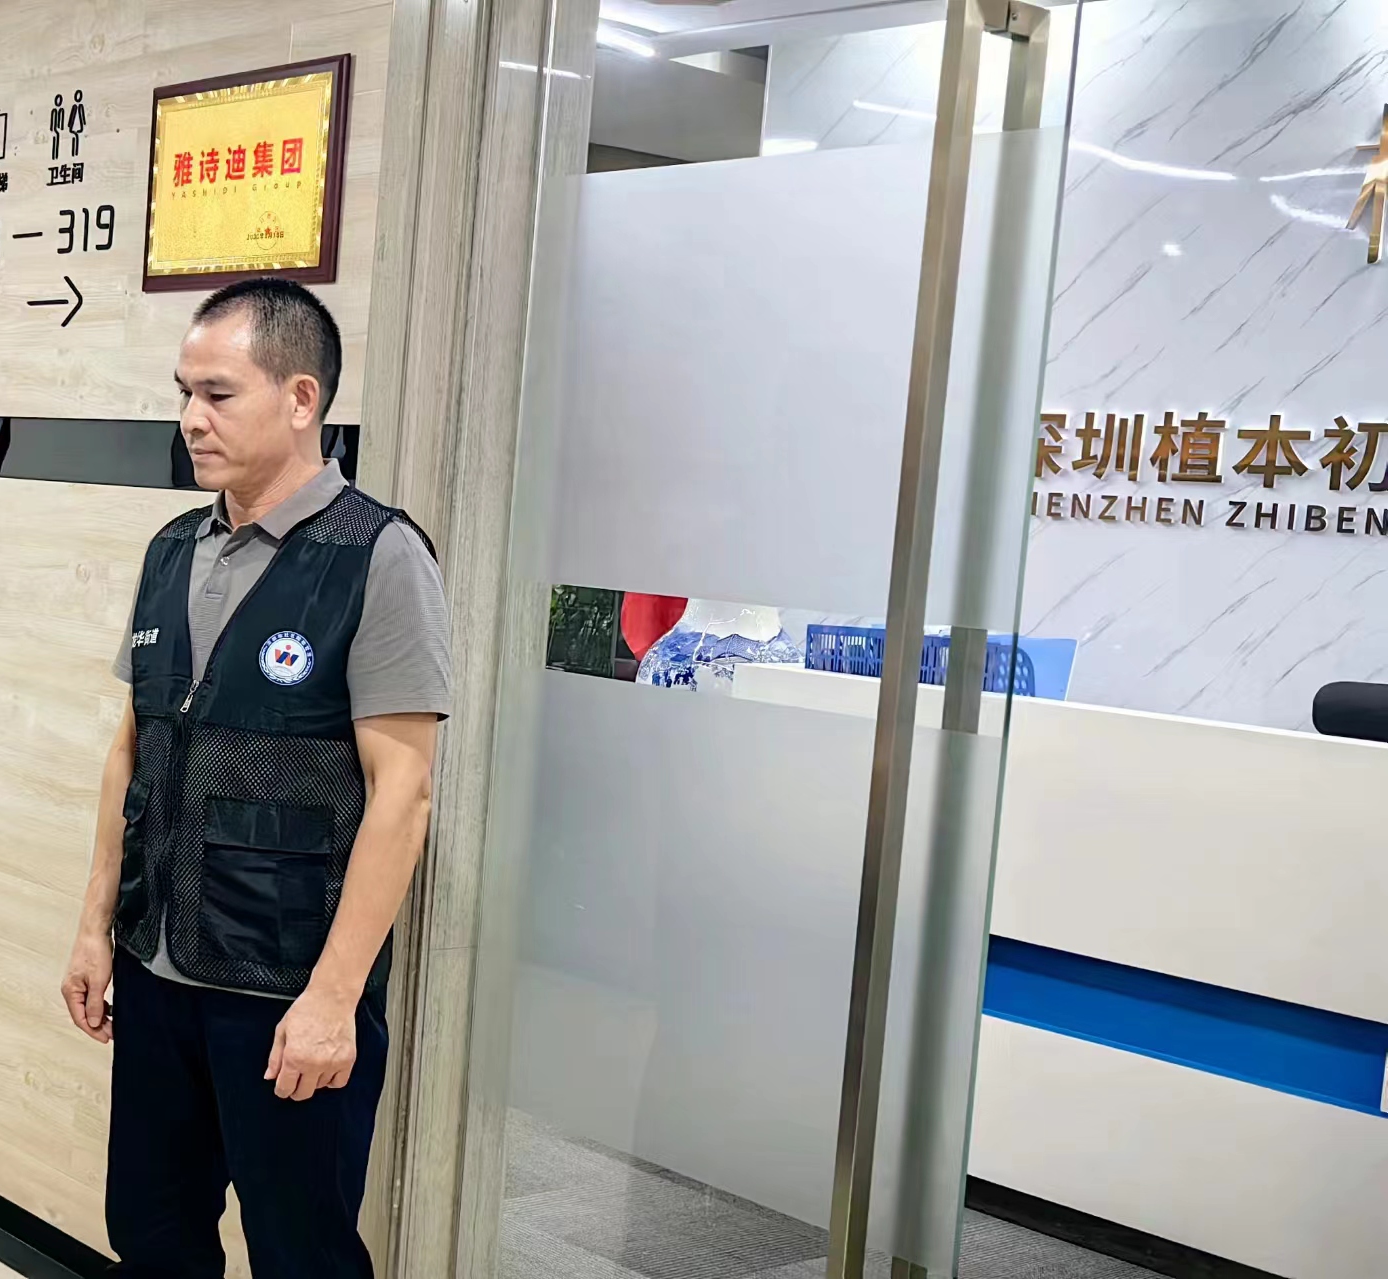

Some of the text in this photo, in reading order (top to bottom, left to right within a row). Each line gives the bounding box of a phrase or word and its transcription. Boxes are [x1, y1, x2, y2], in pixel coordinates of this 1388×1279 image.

[46, 162, 85, 187] 卫生间
[173, 137, 304, 187] 雅诗迪集团
[57, 204, 115, 255] 319
[1035, 411, 1388, 492] 深圳植本初
[1031, 491, 1388, 537] ENZHEN ZHIBEN
